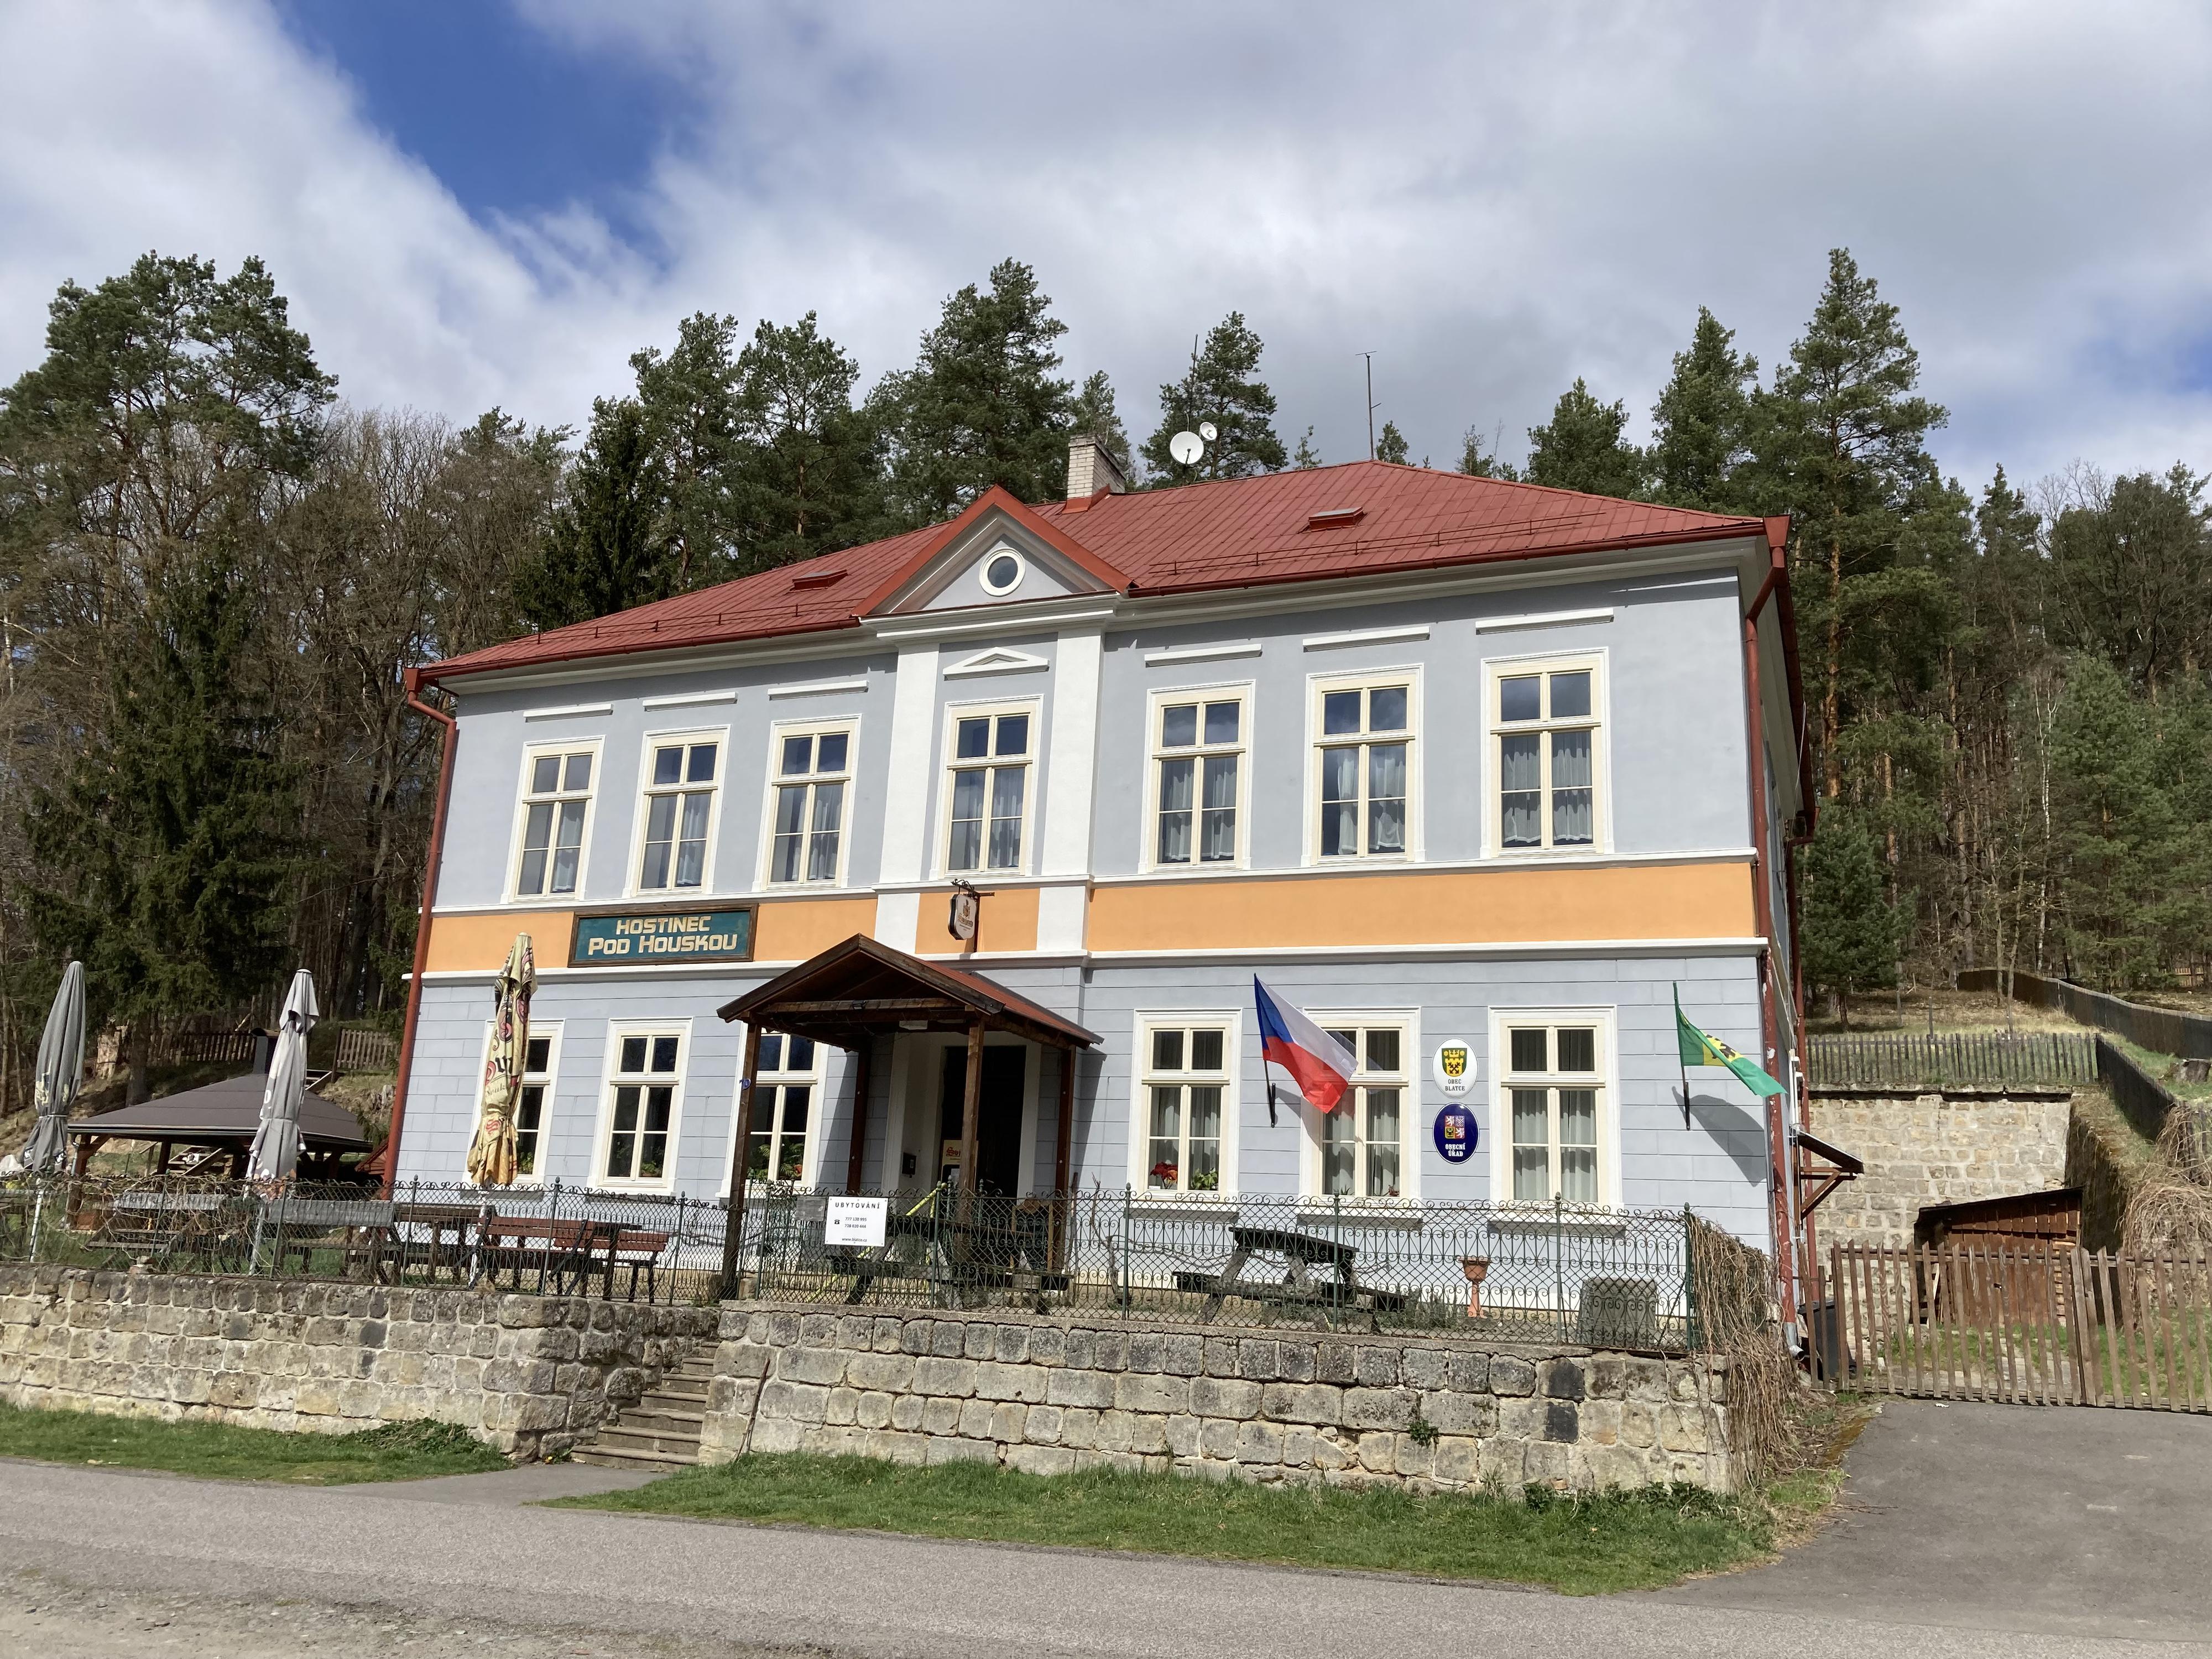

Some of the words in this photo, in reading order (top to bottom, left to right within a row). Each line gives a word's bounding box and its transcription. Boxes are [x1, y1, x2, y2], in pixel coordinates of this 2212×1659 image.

[616, 916, 712, 935] HOSTINEC
[588, 937, 630, 955] POD
[638, 933, 738, 953] HOUSKOU
[1448, 1149, 1463, 1157] ÚŘAD
